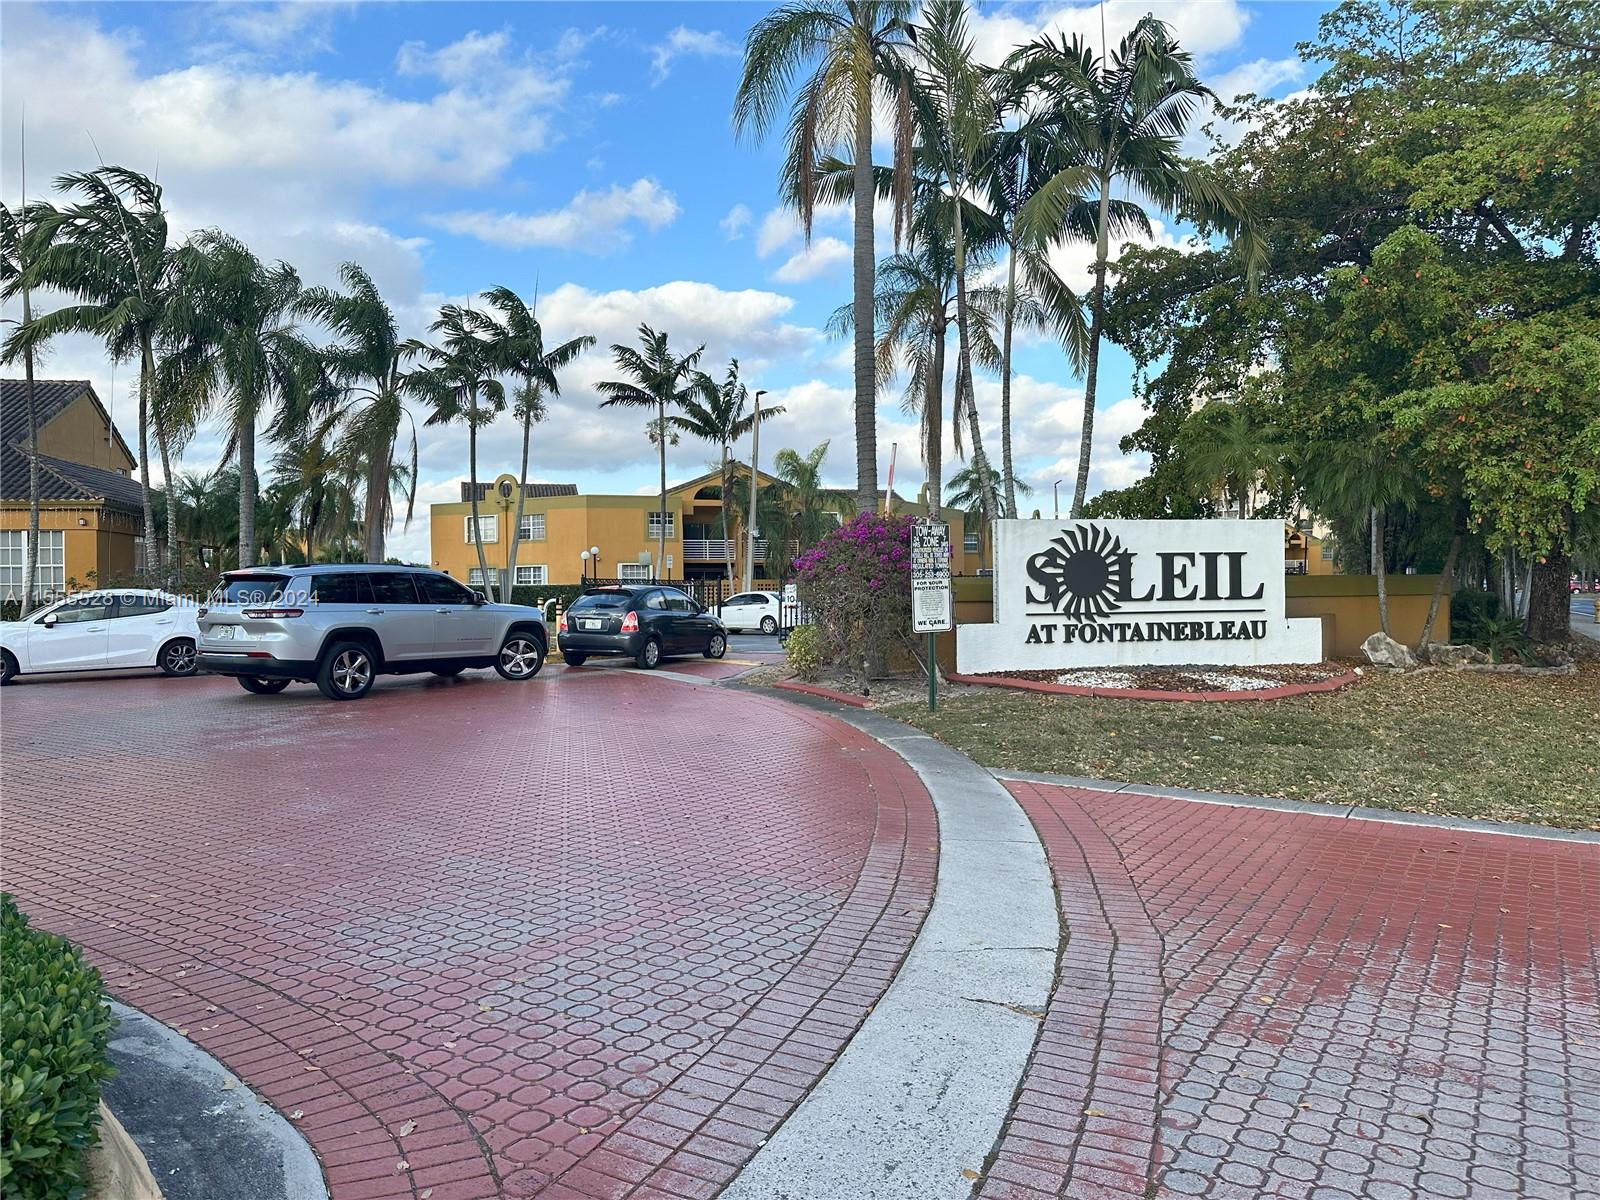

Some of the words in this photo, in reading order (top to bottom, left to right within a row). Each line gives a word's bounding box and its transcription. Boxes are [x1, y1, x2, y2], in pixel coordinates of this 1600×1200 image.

[915, 526, 946, 537] TOW-AWAY
[923, 536, 940, 547] ZONE
[787, 595, 795, 603] 10
[1025, 623, 1057, 644] AT
[1063, 620, 1268, 643] FONTAINEBLEAU
